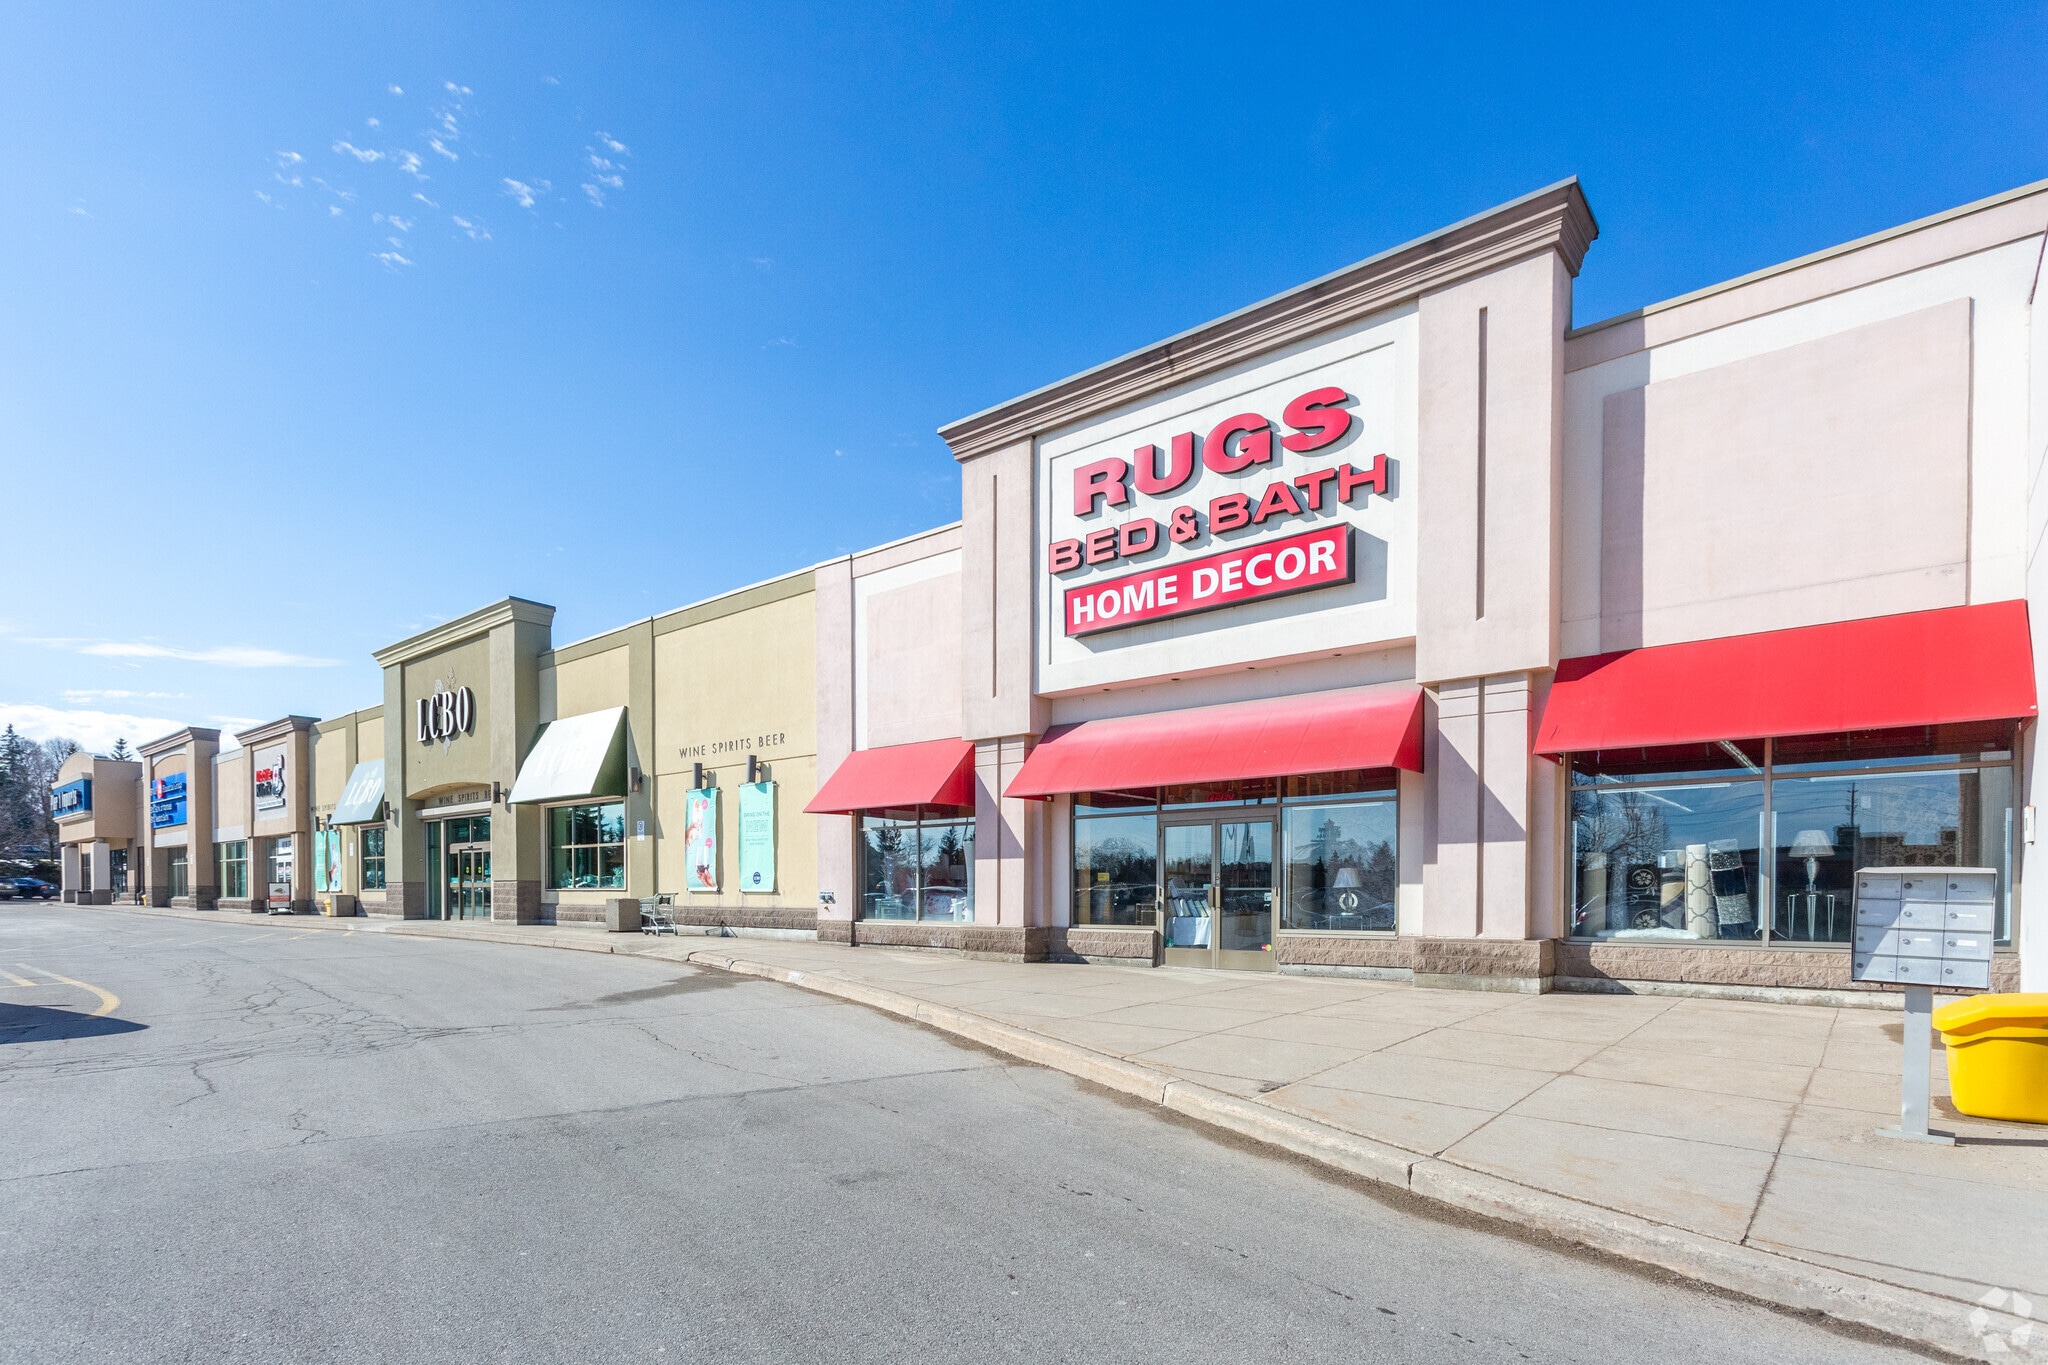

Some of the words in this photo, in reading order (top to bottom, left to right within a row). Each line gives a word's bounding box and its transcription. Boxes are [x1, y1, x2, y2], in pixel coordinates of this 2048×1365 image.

[1073, 386, 1351, 516] RUGS
[1049, 517, 1158, 574] BED
[1168, 505, 1199, 543] &
[1209, 454, 1388, 534] BATH
[1073, 575, 1178, 625] HOME
[1192, 540, 1337, 599] DECOR
[416, 686, 473, 742] LCBO
[679, 745, 706, 759] WINE
[712, 738, 751, 754] SPIRITS
[758, 733, 785, 748] BEER
[344, 777, 382, 806] LCBO
[438, 795, 453, 805] WINE
[458, 791, 479, 802] SPIRITS
[1206, 792, 1235, 802] OPEN
